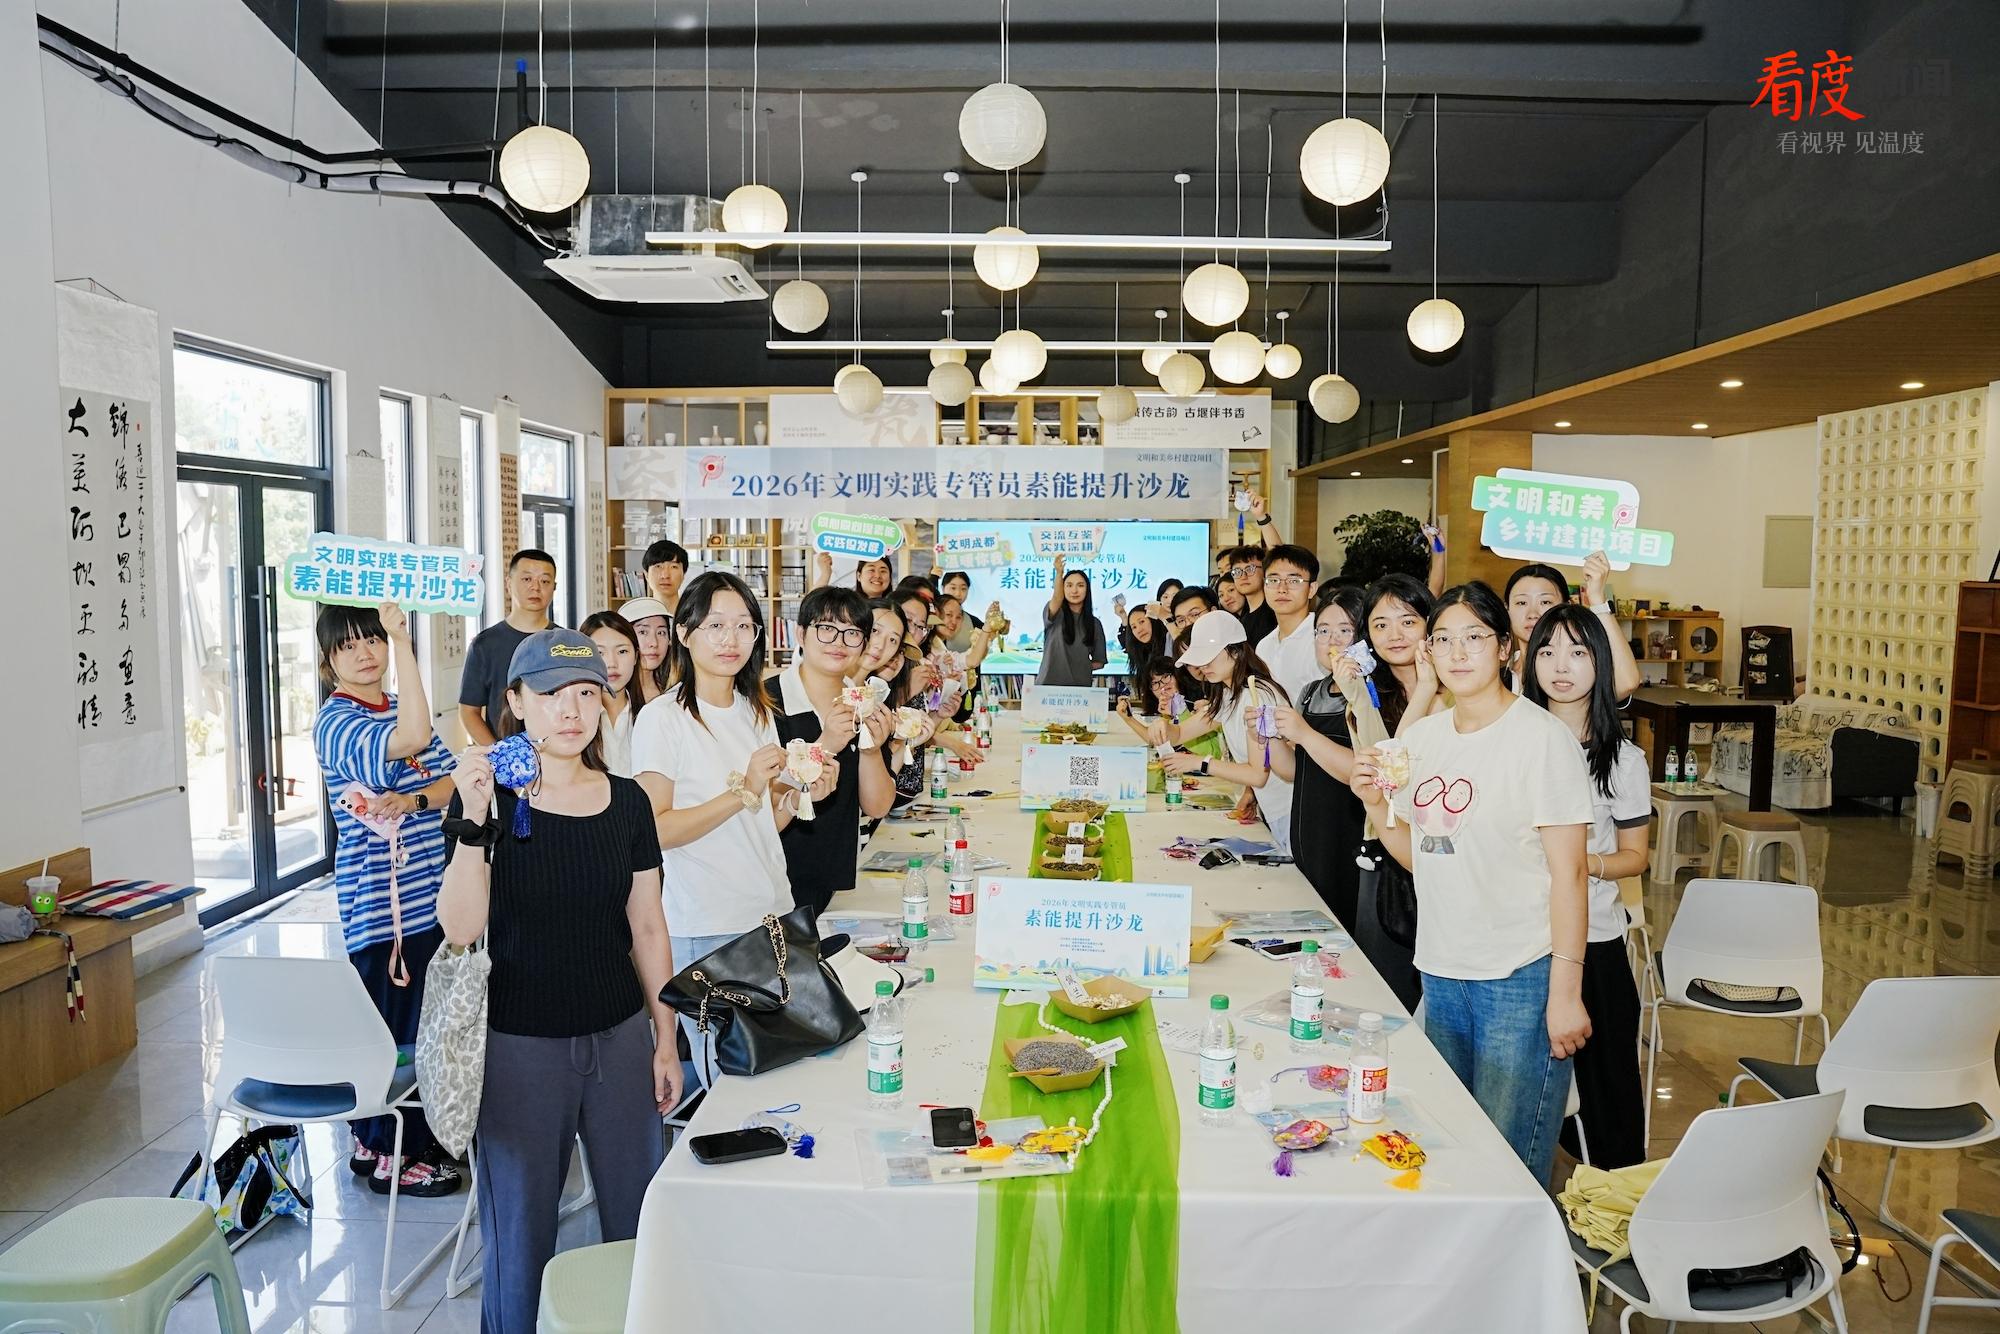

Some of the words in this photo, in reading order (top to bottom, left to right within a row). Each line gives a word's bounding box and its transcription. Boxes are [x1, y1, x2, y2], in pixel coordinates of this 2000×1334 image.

[1184, 407, 1246, 419] 古堰伴书香
[731, 471, 1191, 499] 2026年文明实践专管员素能提升沙龙
[1488, 483, 1605, 520] 文明和美
[948, 536, 995, 550] 文明成都
[1499, 517, 1662, 558] 乡村建设项目
[314, 546, 460, 574] 文明实践专管员
[294, 565, 477, 602] 素能提升沙龙
[1000, 567, 1148, 590] 素能沙龙
[1025, 909, 1144, 932] 素能提升沙龙
